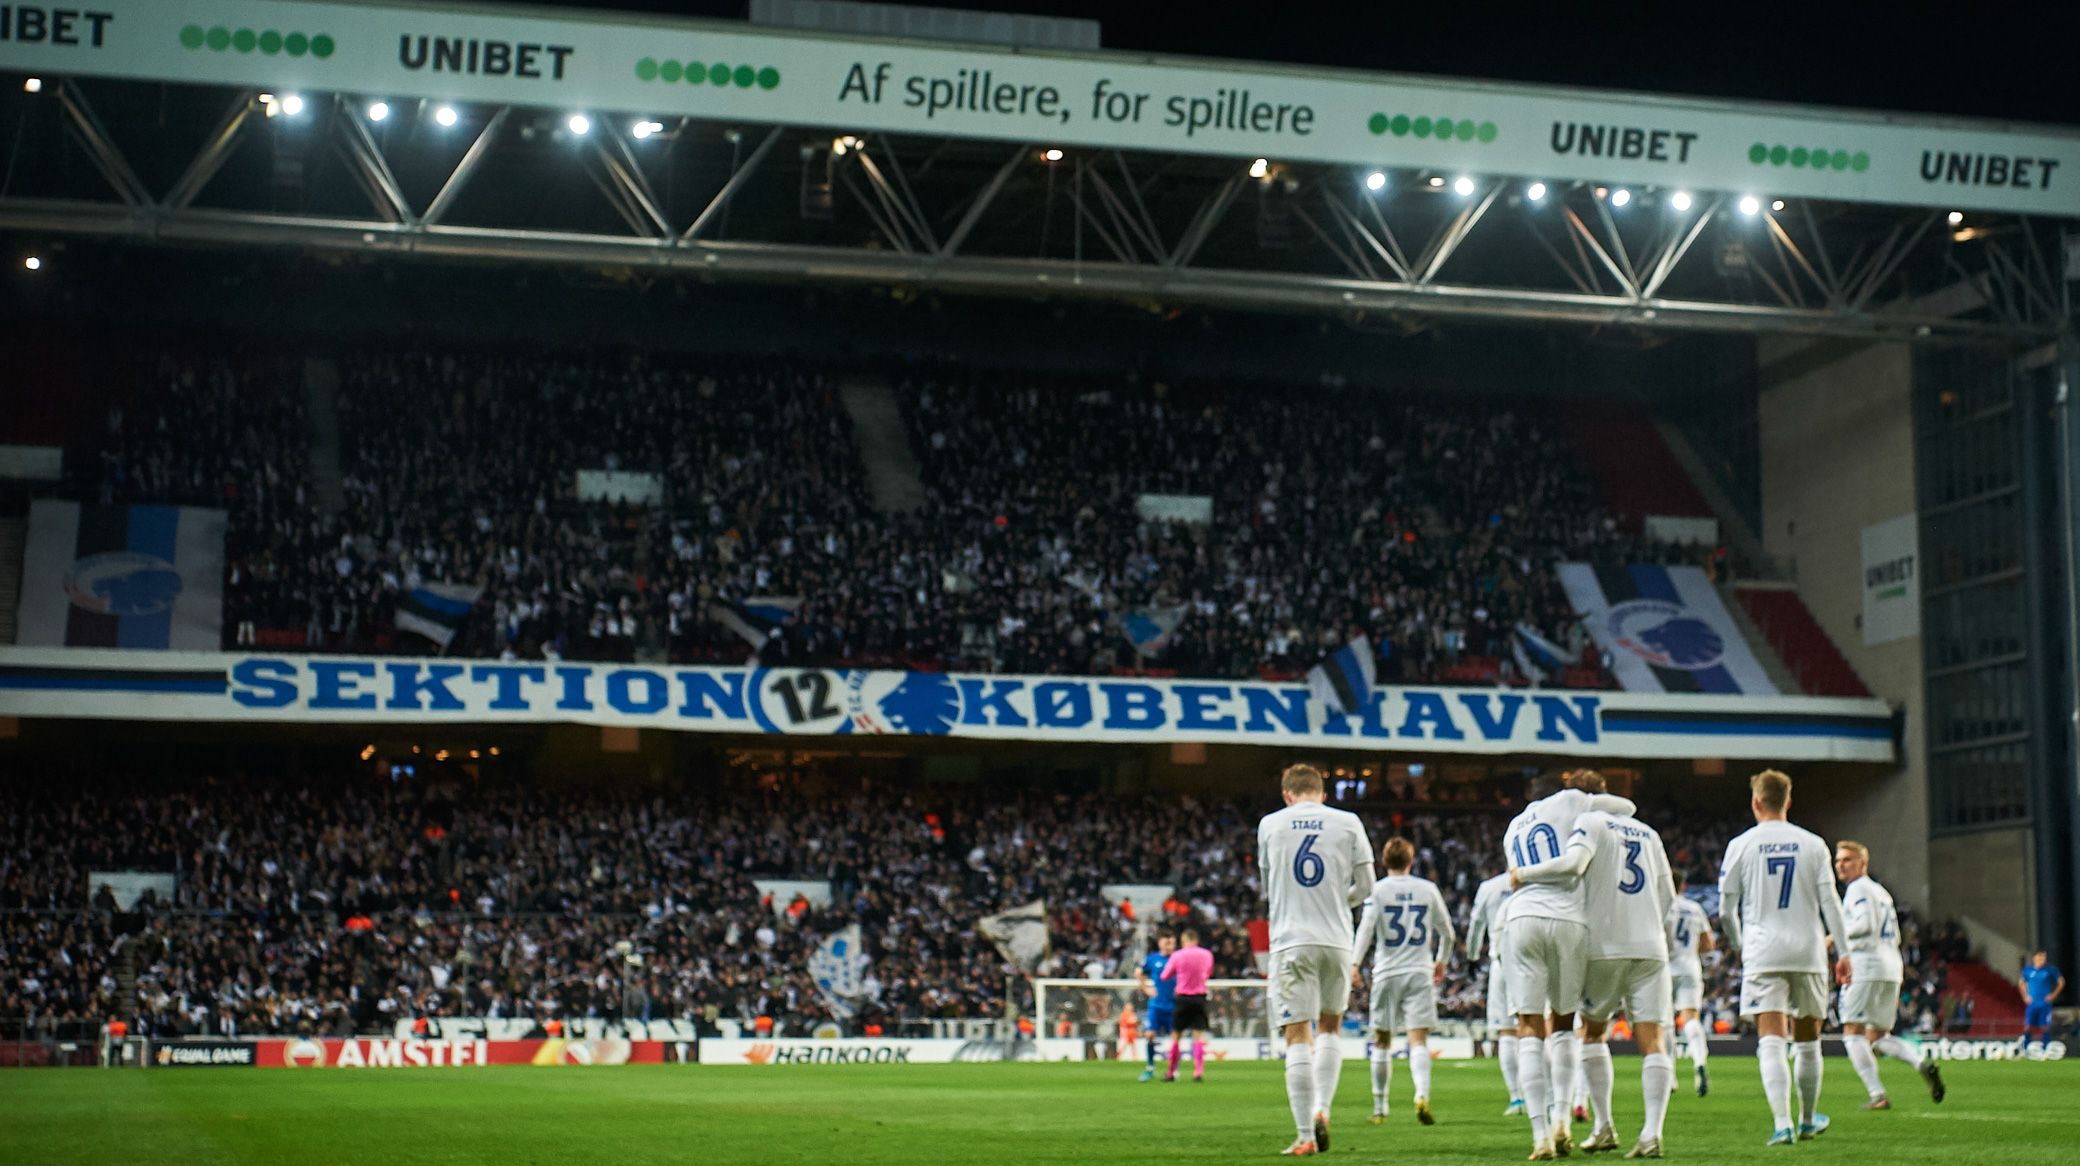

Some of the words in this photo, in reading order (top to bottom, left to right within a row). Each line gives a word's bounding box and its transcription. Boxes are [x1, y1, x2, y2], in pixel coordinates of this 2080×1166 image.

[399, 34, 574, 80] UNIBET
[838, 62, 892, 104] Af
[903, 68, 1071, 124] spillere,
[1092, 78, 1150, 123] for
[1164, 88, 1314, 137] spillere
[1550, 121, 1698, 164] UNIBET
[1920, 150, 2060, 190] UNIBET
[231, 658, 748, 718] SEKTION
[769, 671, 841, 724] 12
[957, 679, 1600, 744] KØBENHAVN
[1292, 820, 1324, 830] STAGE
[1512, 823, 1560, 868] 10
[1293, 834, 1325, 887] 6
[1619, 841, 1646, 894] 3
[1758, 842, 1799, 854] FISCHER
[1767, 857, 1796, 909] 7
[1384, 905, 1428, 947] 33
[1676, 917, 1690, 948] 4
